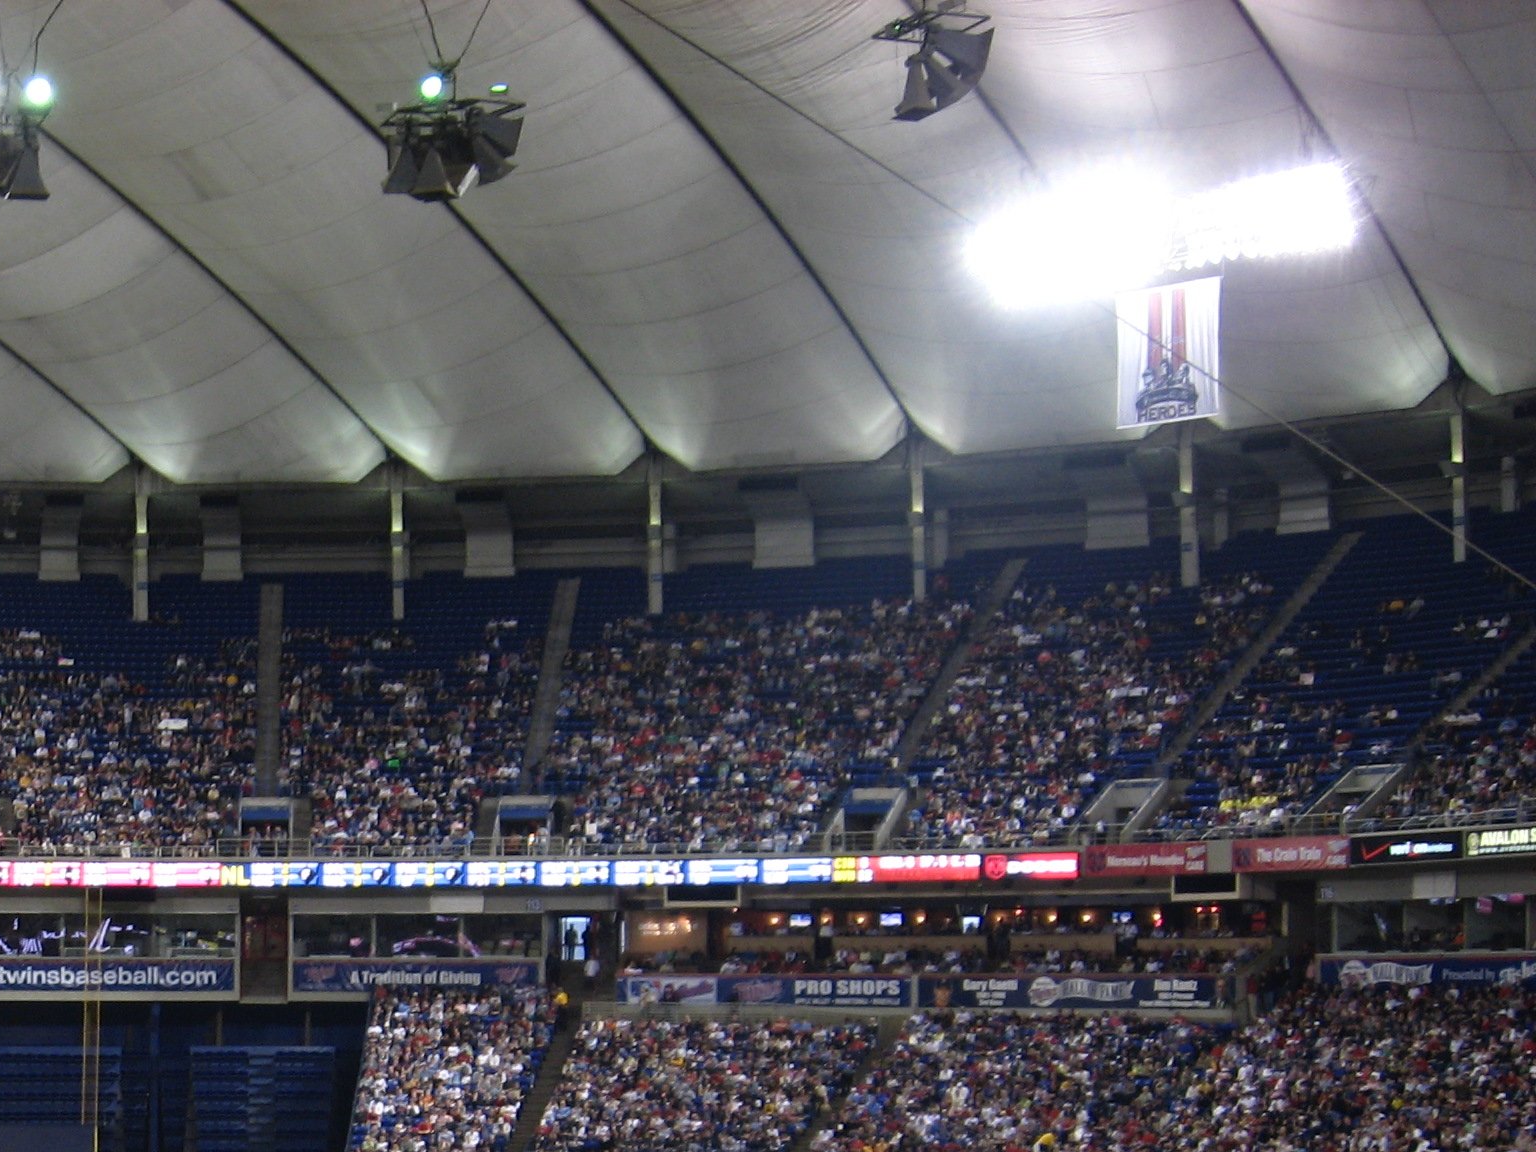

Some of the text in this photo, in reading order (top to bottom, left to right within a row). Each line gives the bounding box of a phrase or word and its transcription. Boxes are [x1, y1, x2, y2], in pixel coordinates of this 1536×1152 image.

[1137, 403, 1196, 423] HEROES
[1480, 829, 1529, 847] AVALON
[220, 865, 251, 886] NL
[350, 971, 360, 984] A
[361, 971, 422, 985] Tradition
[423, 971, 437, 984] of
[439, 971, 481, 986] Giving
[794, 980, 832, 995] PRO
[836, 980, 901, 995] SHOPS
